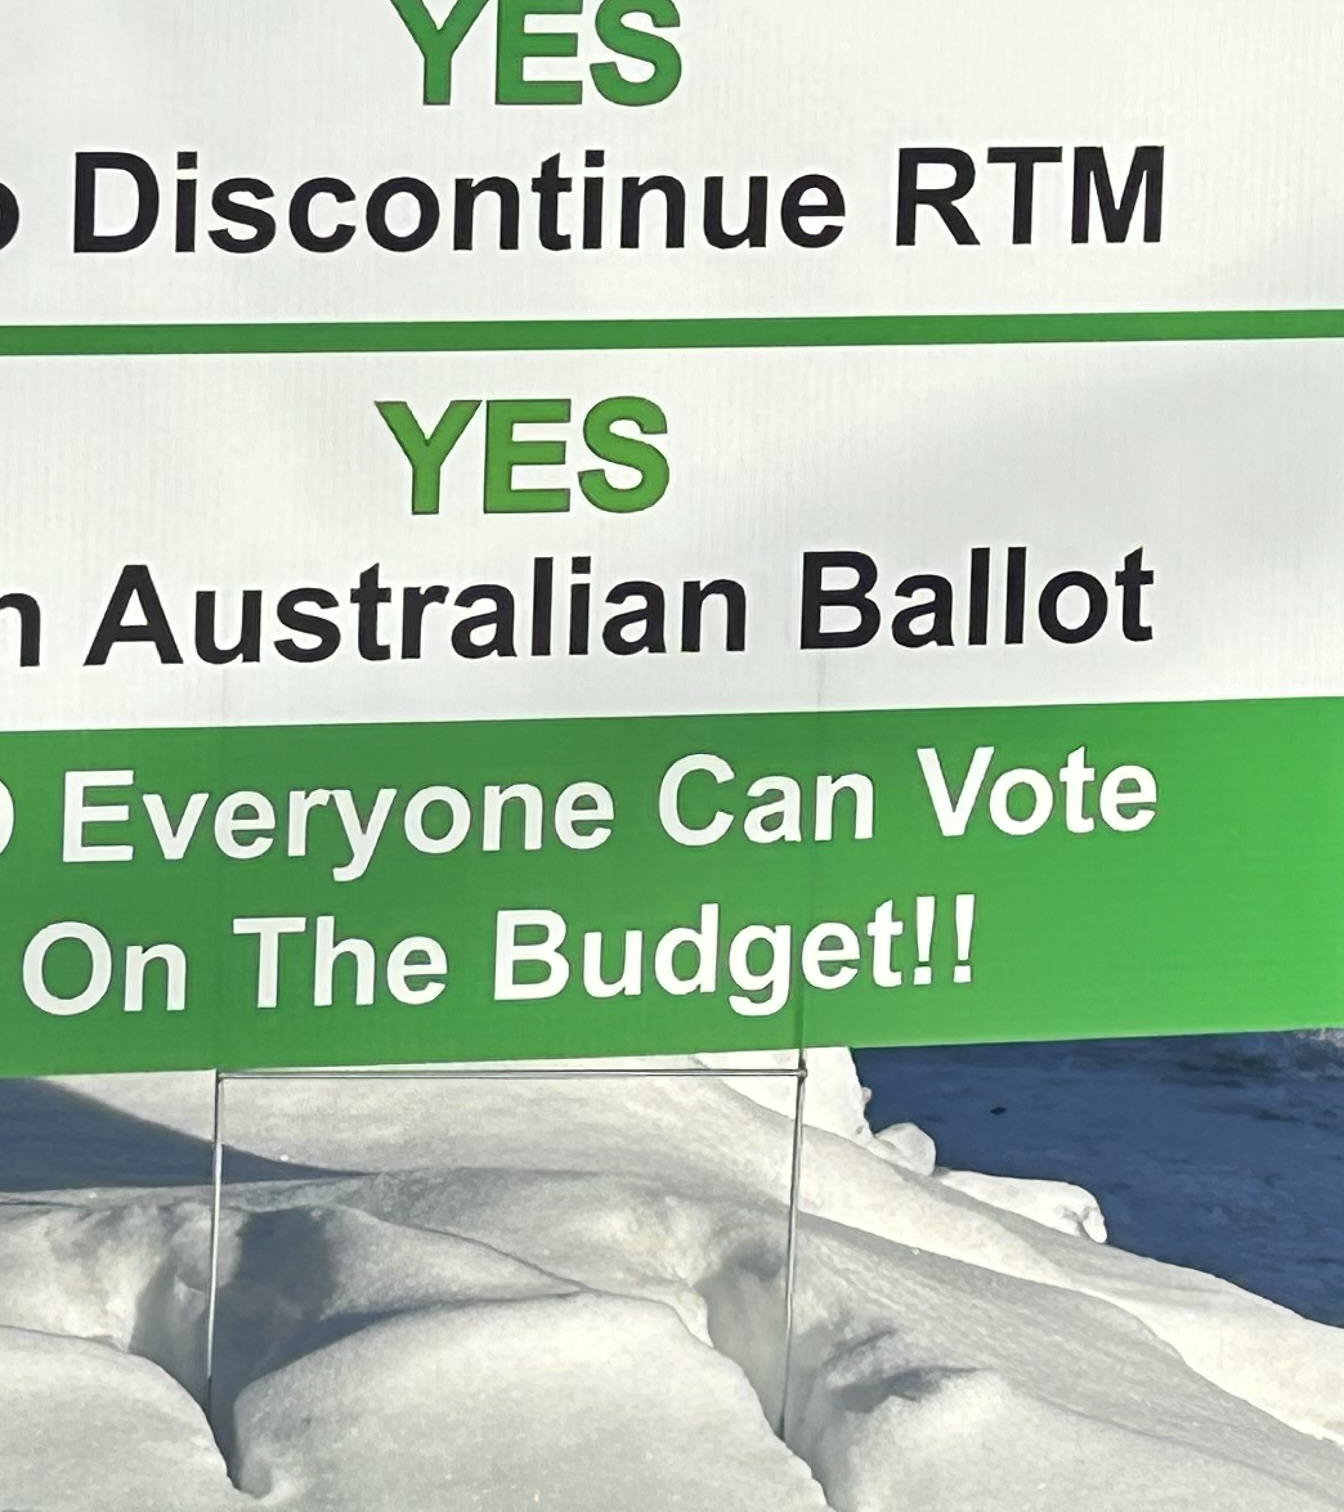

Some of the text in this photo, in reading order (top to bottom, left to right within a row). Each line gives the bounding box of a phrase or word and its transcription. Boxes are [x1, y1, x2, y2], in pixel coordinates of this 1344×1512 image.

[73, 149, 846, 254] Discontinue
[896, 145, 1165, 247] RTM
[377, 396, 668, 516] YES
[83, 556, 746, 666] Australian
[800, 546, 1154, 650] Ballot
[62, 769, 615, 882] Everyone
[658, 753, 874, 846] Can
[916, 746, 1157, 837] Vote
[22, 893, 975, 1017] On The Budget!!
